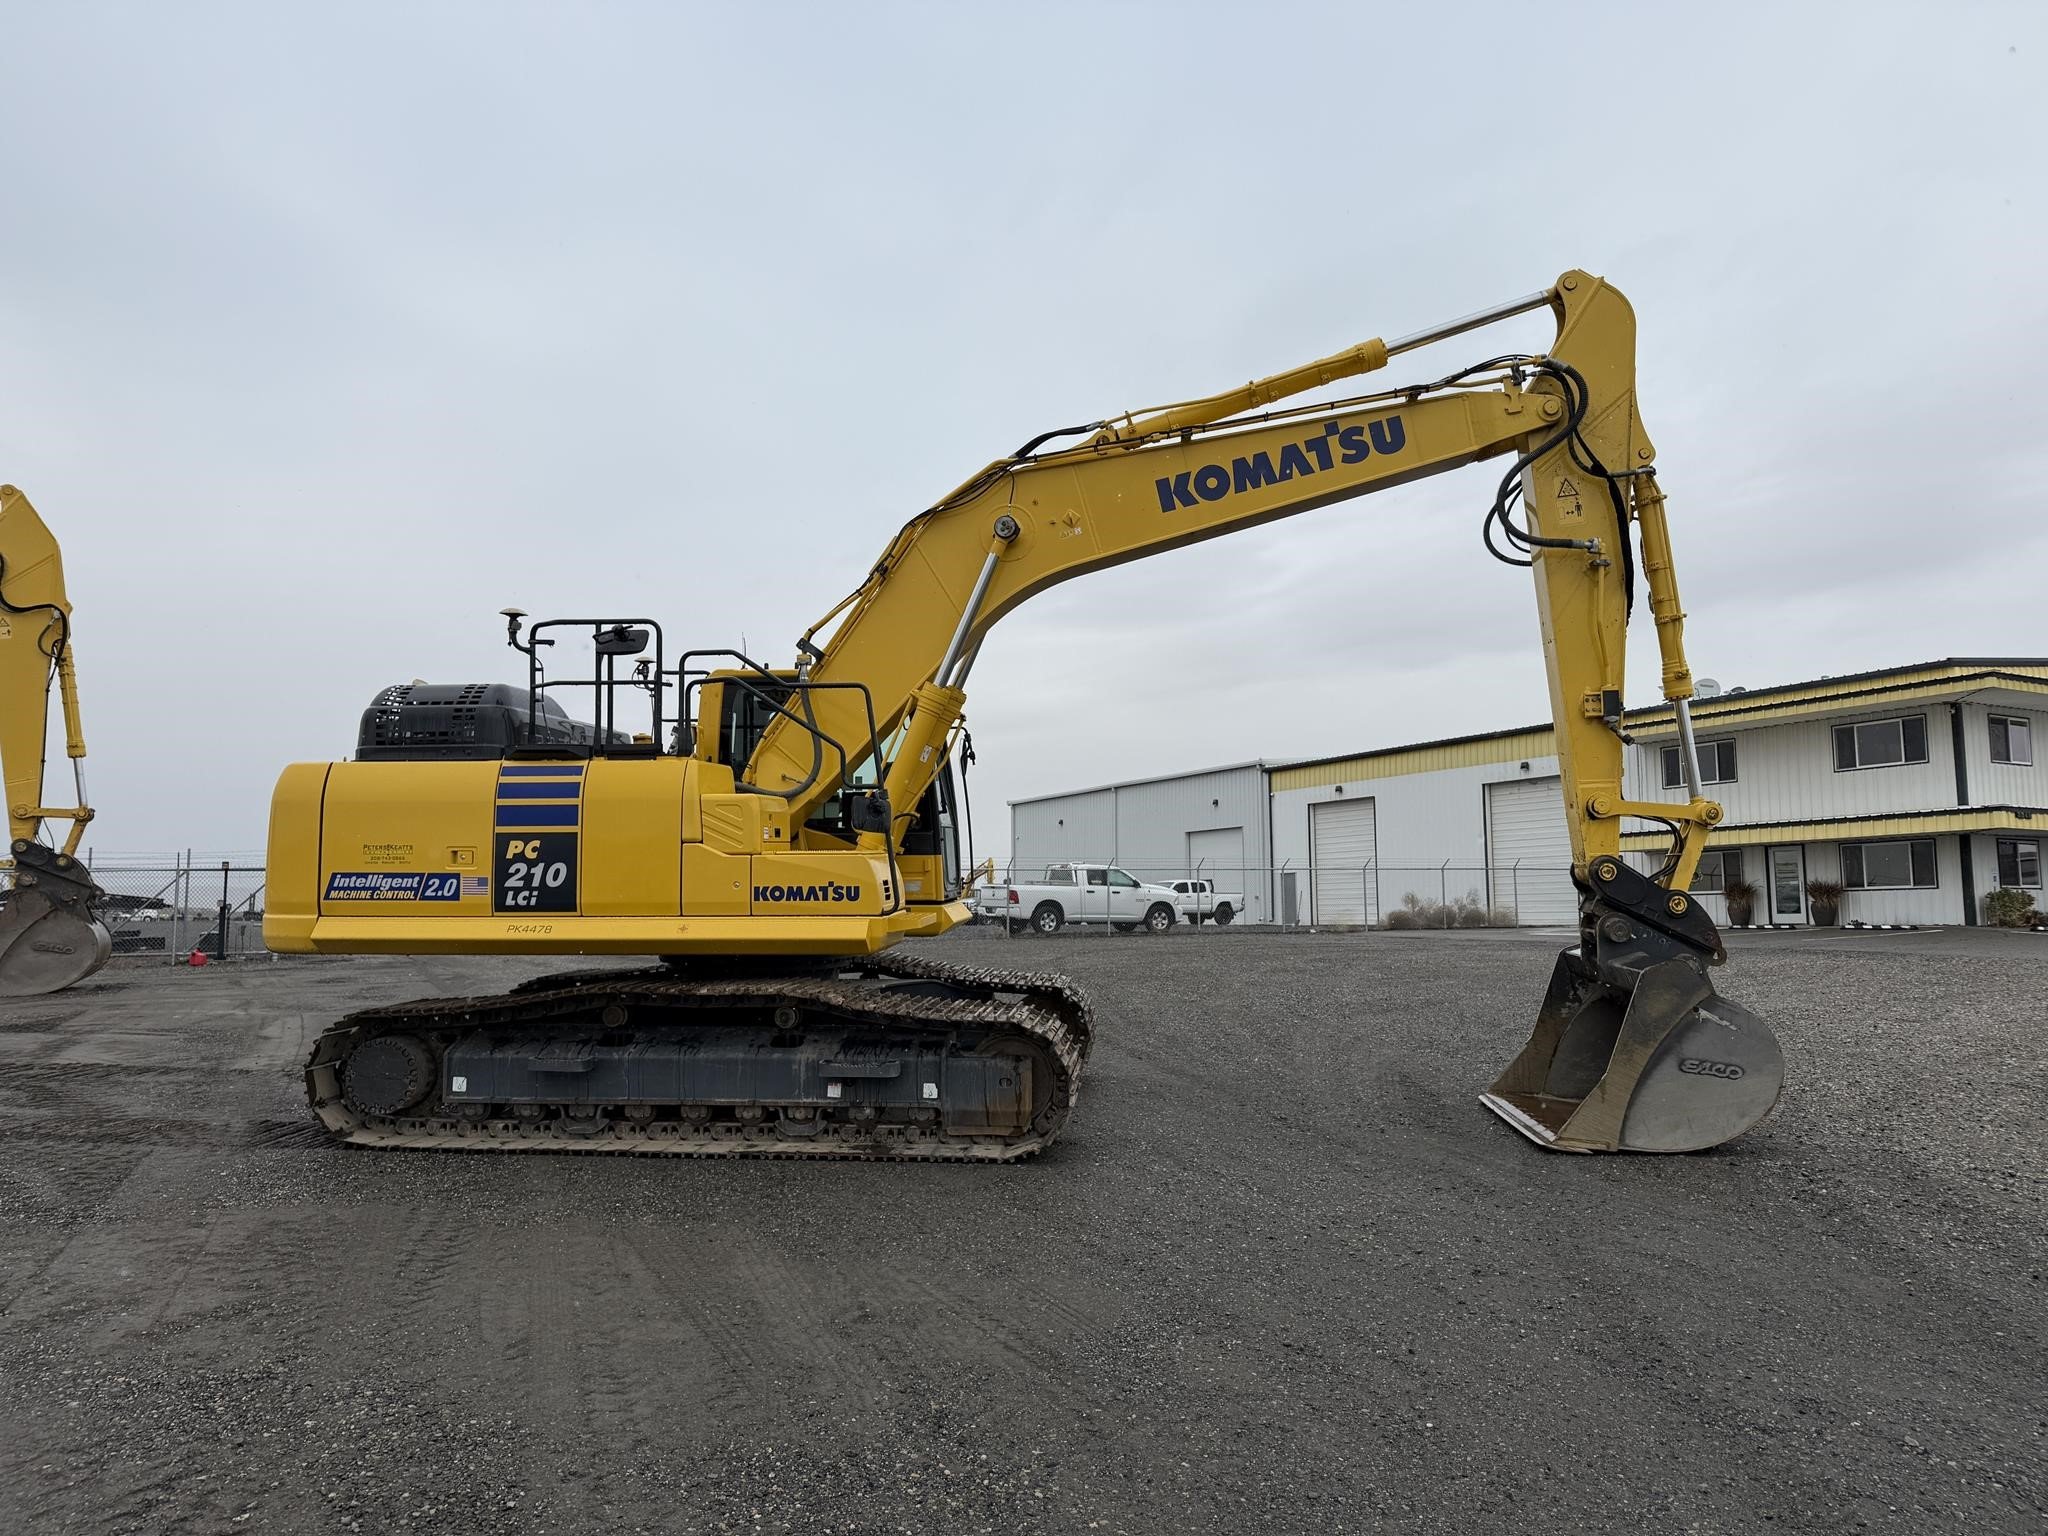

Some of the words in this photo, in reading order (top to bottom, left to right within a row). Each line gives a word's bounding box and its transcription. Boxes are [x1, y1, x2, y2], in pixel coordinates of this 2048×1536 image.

[1155, 415, 1406, 513] KOMATSU
[505, 840, 541, 859] PC
[333, 874, 420, 890] intelligent
[504, 862, 567, 888] 210
[329, 889, 372, 899] MACHINE
[373, 889, 415, 899] CONTROL
[424, 878, 458, 897] 2.0
[753, 881, 860, 902] KOMATSU
[505, 890, 538, 906] LCi
[507, 924, 553, 934] PK4478
